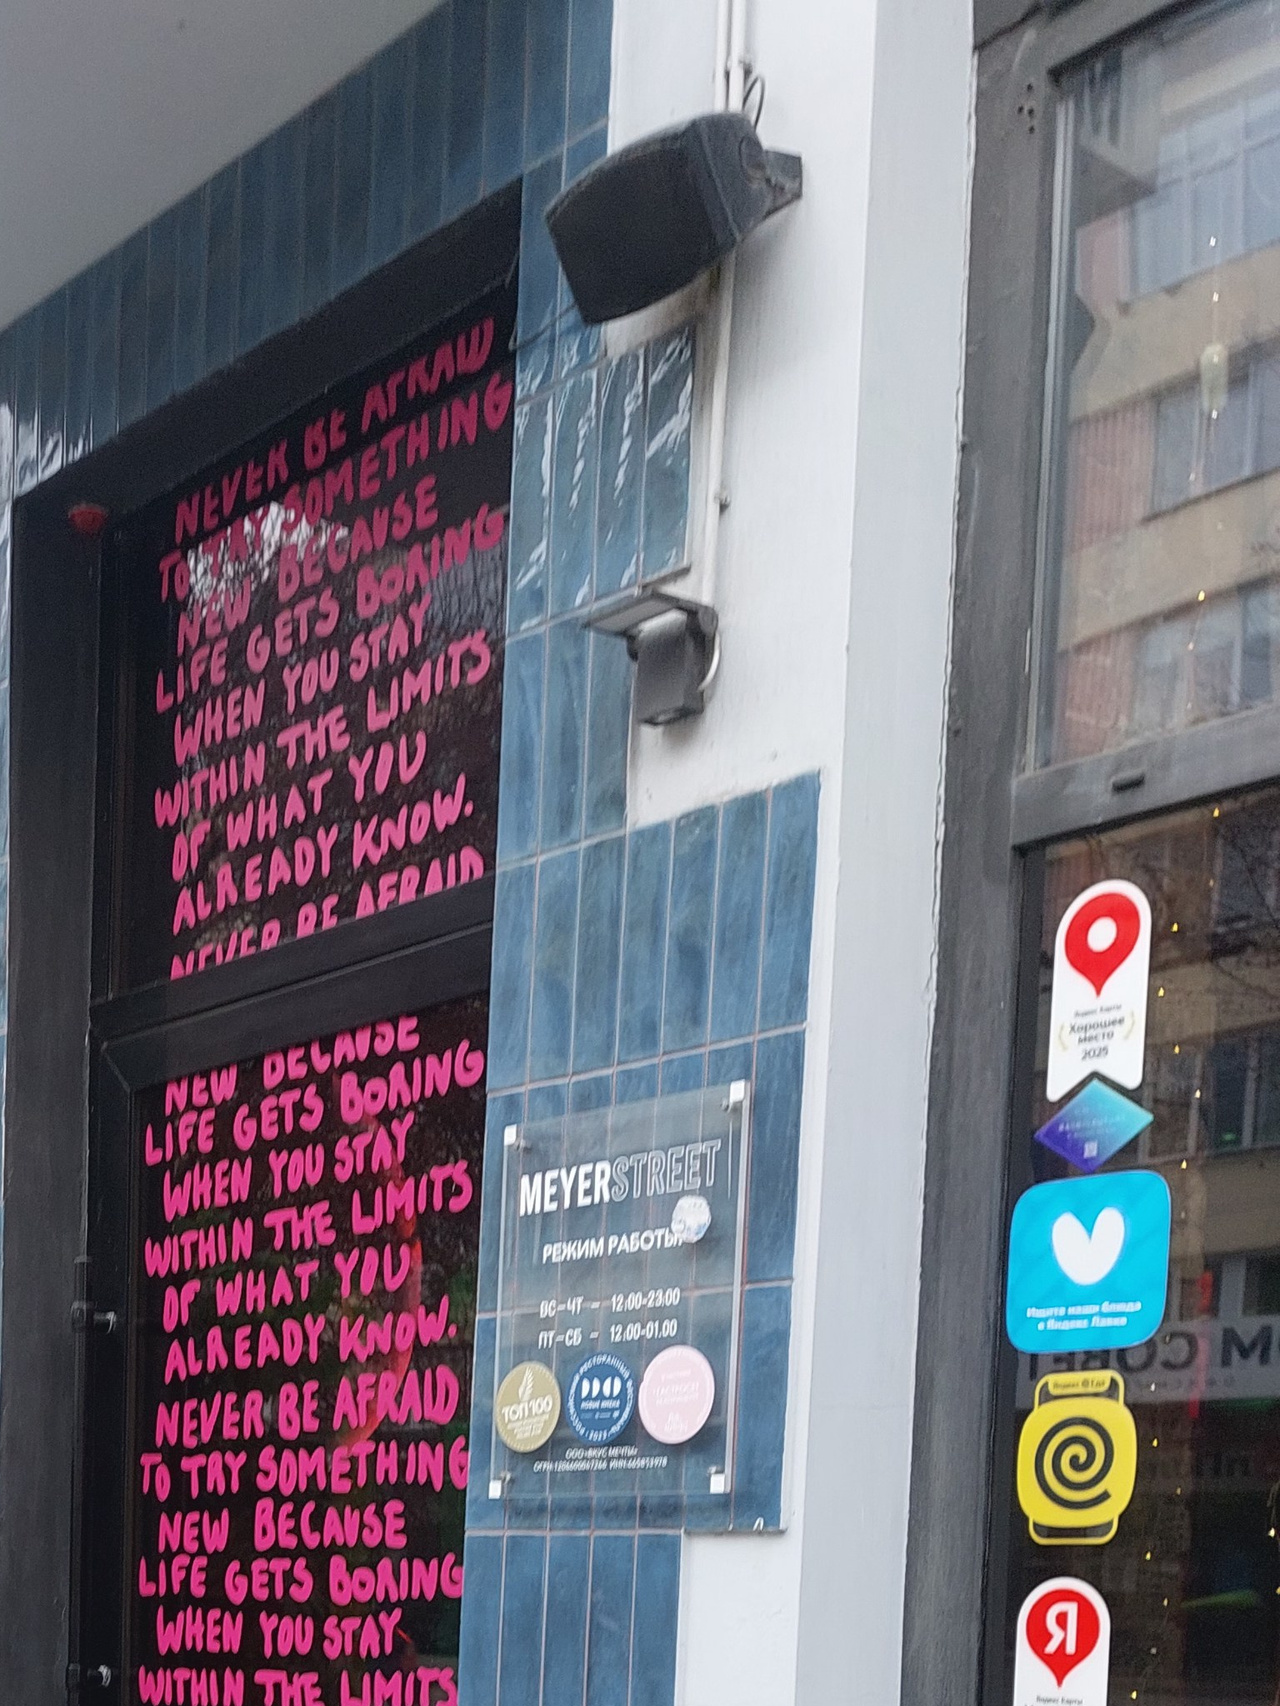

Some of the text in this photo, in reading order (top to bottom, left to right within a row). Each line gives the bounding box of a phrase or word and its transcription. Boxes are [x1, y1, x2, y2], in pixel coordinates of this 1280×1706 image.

[158, 547, 190, 603] TO
[283, 372, 513, 532] SOMETHING
[176, 439, 289, 545] NEVER
[304, 408, 347, 472] BE
[156, 502, 505, 714] LIFE GETS BORING
[177, 473, 438, 657] NEW BECAUSE
[154, 628, 491, 828] WITHIN THE LIMITS
[174, 593, 432, 767] WHEN YOU STAY
[172, 730, 427, 882] OF WHAT YOU
[173, 773, 474, 936] ALREADY KNOW.
[145, 1039, 485, 1166] LIFE GETS BORING
[165, 1064, 237, 1116] NEW
[144, 1159, 473, 1278] WITHIN THE LIMITS
[163, 1111, 414, 1223] WHEN YOU STAY
[163, 1242, 410, 1332] OF WHAT YOU
[542, 1236, 604, 1264] РЕЖИМ
[165, 1294, 457, 1385] ALREADY KNOW.
[155, 1390, 264, 1448] NEVER
[278, 1380, 320, 1441] BE
[332, 1364, 460, 1431] AFRAID
[140, 1435, 470, 1502] TO TRY SOMETHING
[138, 1552, 463, 1606] LIFE GETS BORING
[158, 1497, 408, 1554] NEW BECAUSE
[156, 1605, 403, 1660] WHEN YOU STAY
[1043, 1601, 1079, 1656] Я
